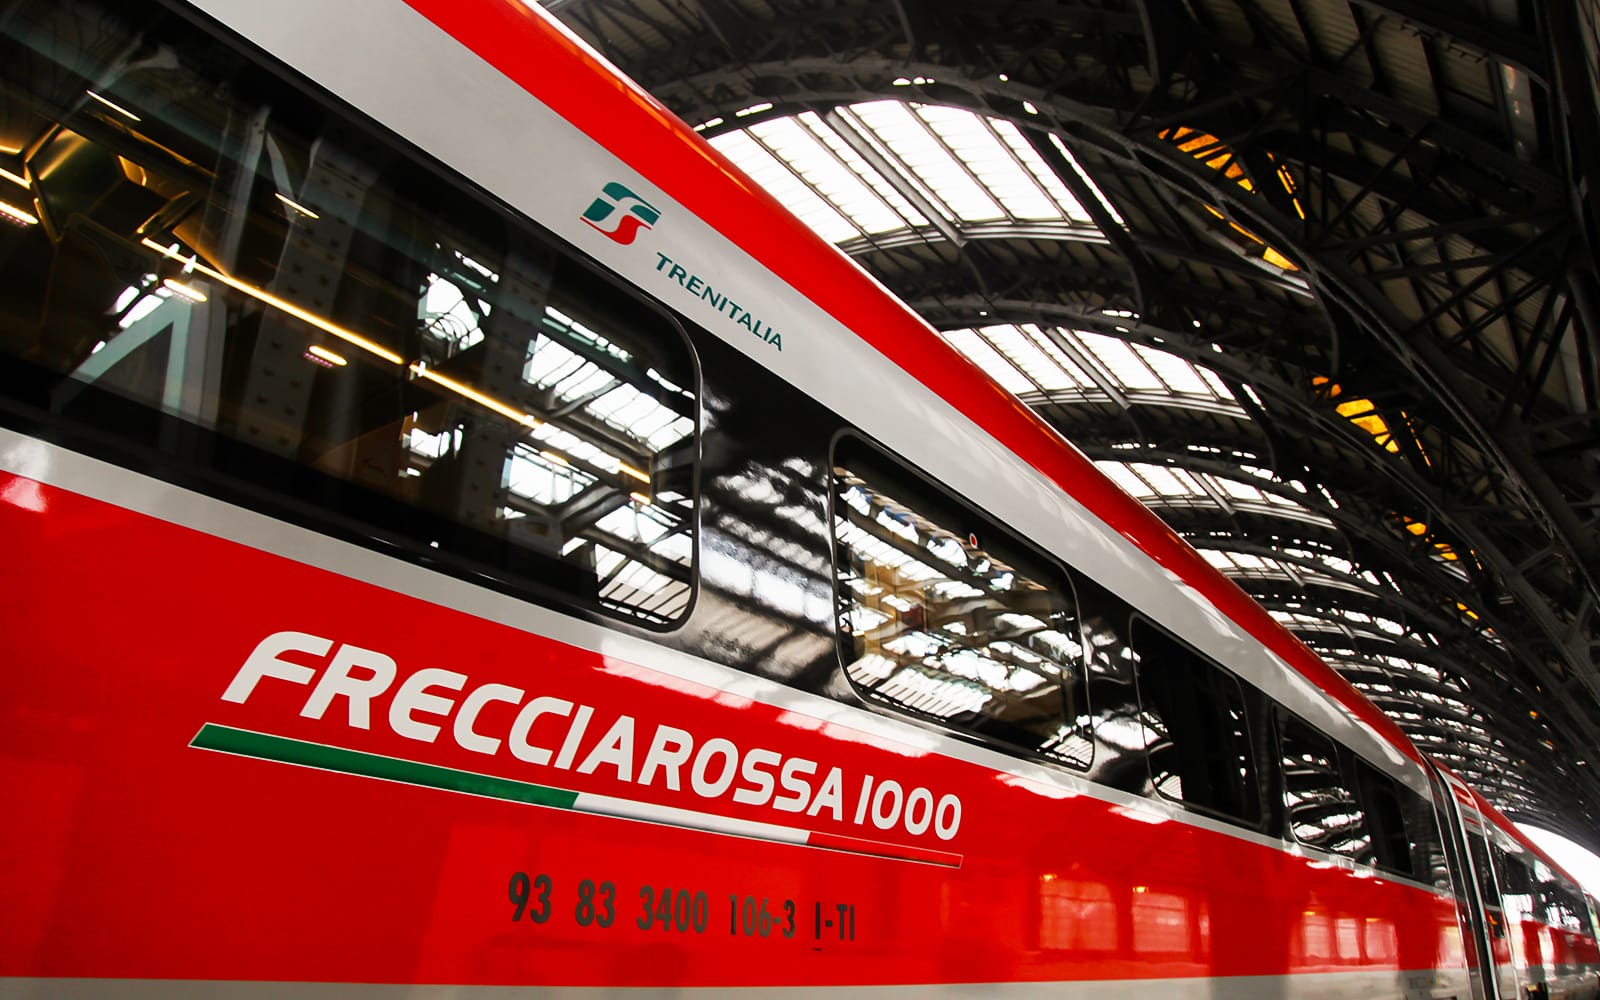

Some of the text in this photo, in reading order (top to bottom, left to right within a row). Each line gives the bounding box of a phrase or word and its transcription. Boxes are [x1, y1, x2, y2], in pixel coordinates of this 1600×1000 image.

[655, 251, 783, 352] TRENITALIA
[220, 630, 962, 841] FRECCIAROSSA 1000
[508, 871, 553, 925] 93
[574, 878, 616, 929] 83
[635, 884, 709, 934] 3400
[728, 893, 796, 939] 106-3
